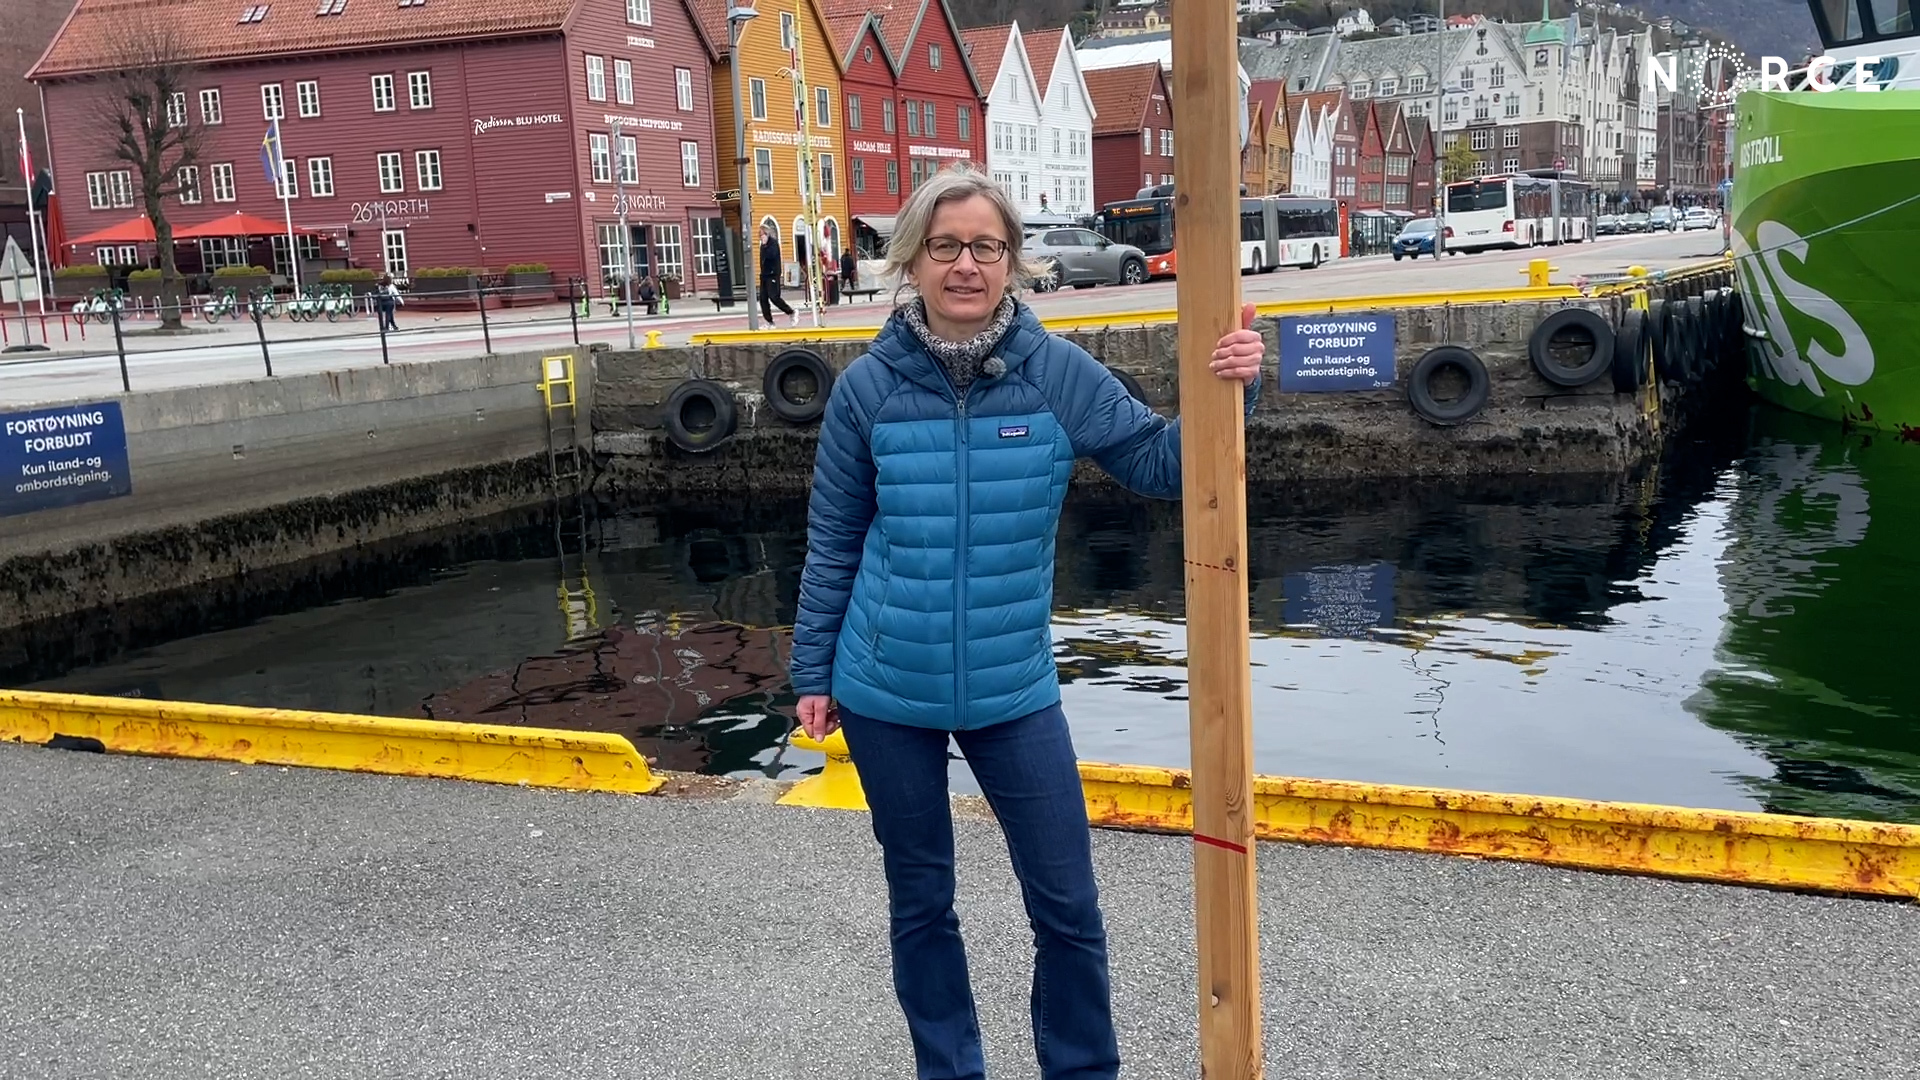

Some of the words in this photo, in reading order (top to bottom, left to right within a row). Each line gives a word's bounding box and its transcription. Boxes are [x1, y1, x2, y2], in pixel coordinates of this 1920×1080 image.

[474, 115, 514, 136] Radisson
[515, 116, 532, 125] BLU
[534, 113, 563, 124] HOTEL
[351, 202, 372, 223] 26
[374, 198, 429, 215] NORTH
[629, 195, 666, 210] NORTH
[1296, 321, 1377, 335] FORTØYNING
[1308, 336, 1366, 349] FORBUDT
[1303, 356, 1323, 365] Kun
[1324, 355, 1355, 364] iland-
[1356, 356, 1370, 365] og
[1296, 366, 1378, 377] ombordstigning.
[6, 411, 104, 436] FORTØYNING
[25, 431, 93, 454] FORBUDT
[22, 464, 46, 476] Kun
[48, 457, 85, 472] iland-
[86, 456, 102, 468] og
[15, 470, 112, 493] ombordstigning.
